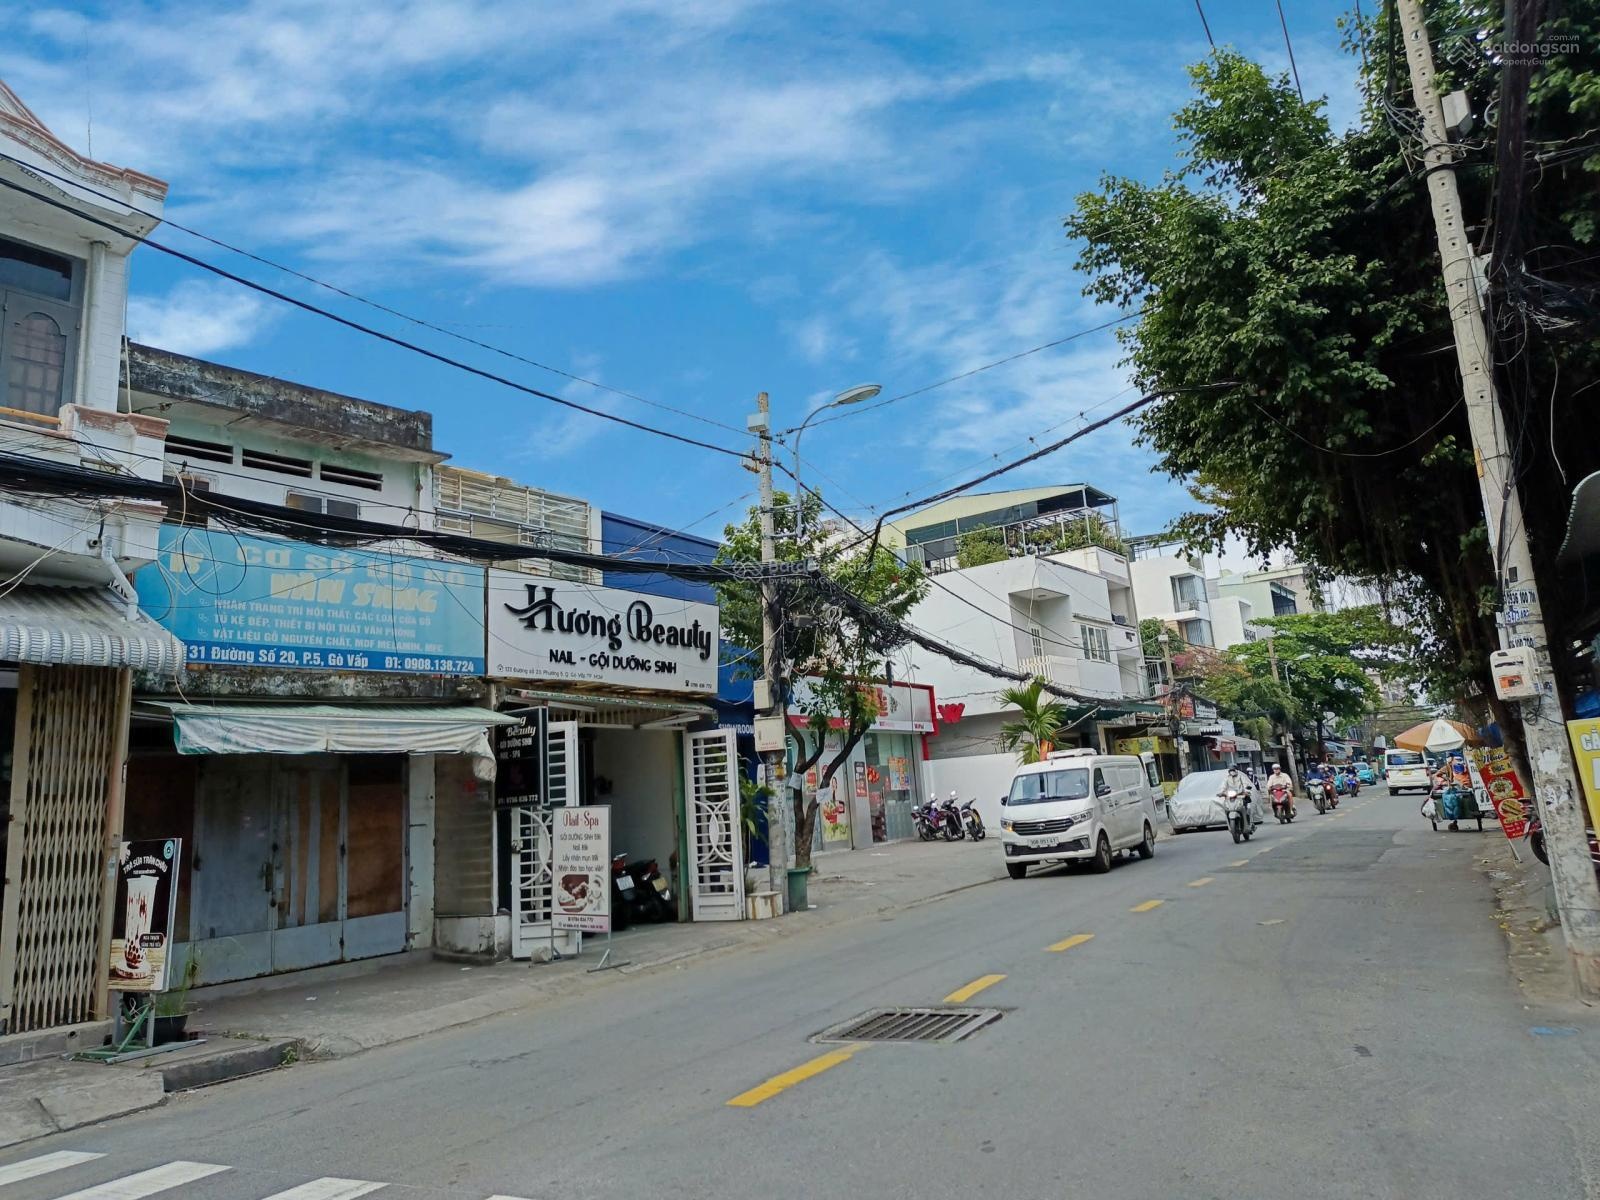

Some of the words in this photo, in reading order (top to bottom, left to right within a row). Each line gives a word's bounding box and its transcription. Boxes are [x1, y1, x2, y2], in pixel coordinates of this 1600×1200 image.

[503, 583, 622, 651] Hương
[627, 600, 712, 661] Beauty
[210, 646, 255, 663] Đường
[258, 647, 278, 663] Số
[327, 653, 344, 667] Gò
[346, 652, 369, 669] Vấp
[549, 648, 577, 666] NAIL
[588, 651, 610, 670] GỘI
[612, 654, 652, 672] DƯỠNG
[654, 660, 677, 675] SINH
[583, 810, 599, 831] Spa
